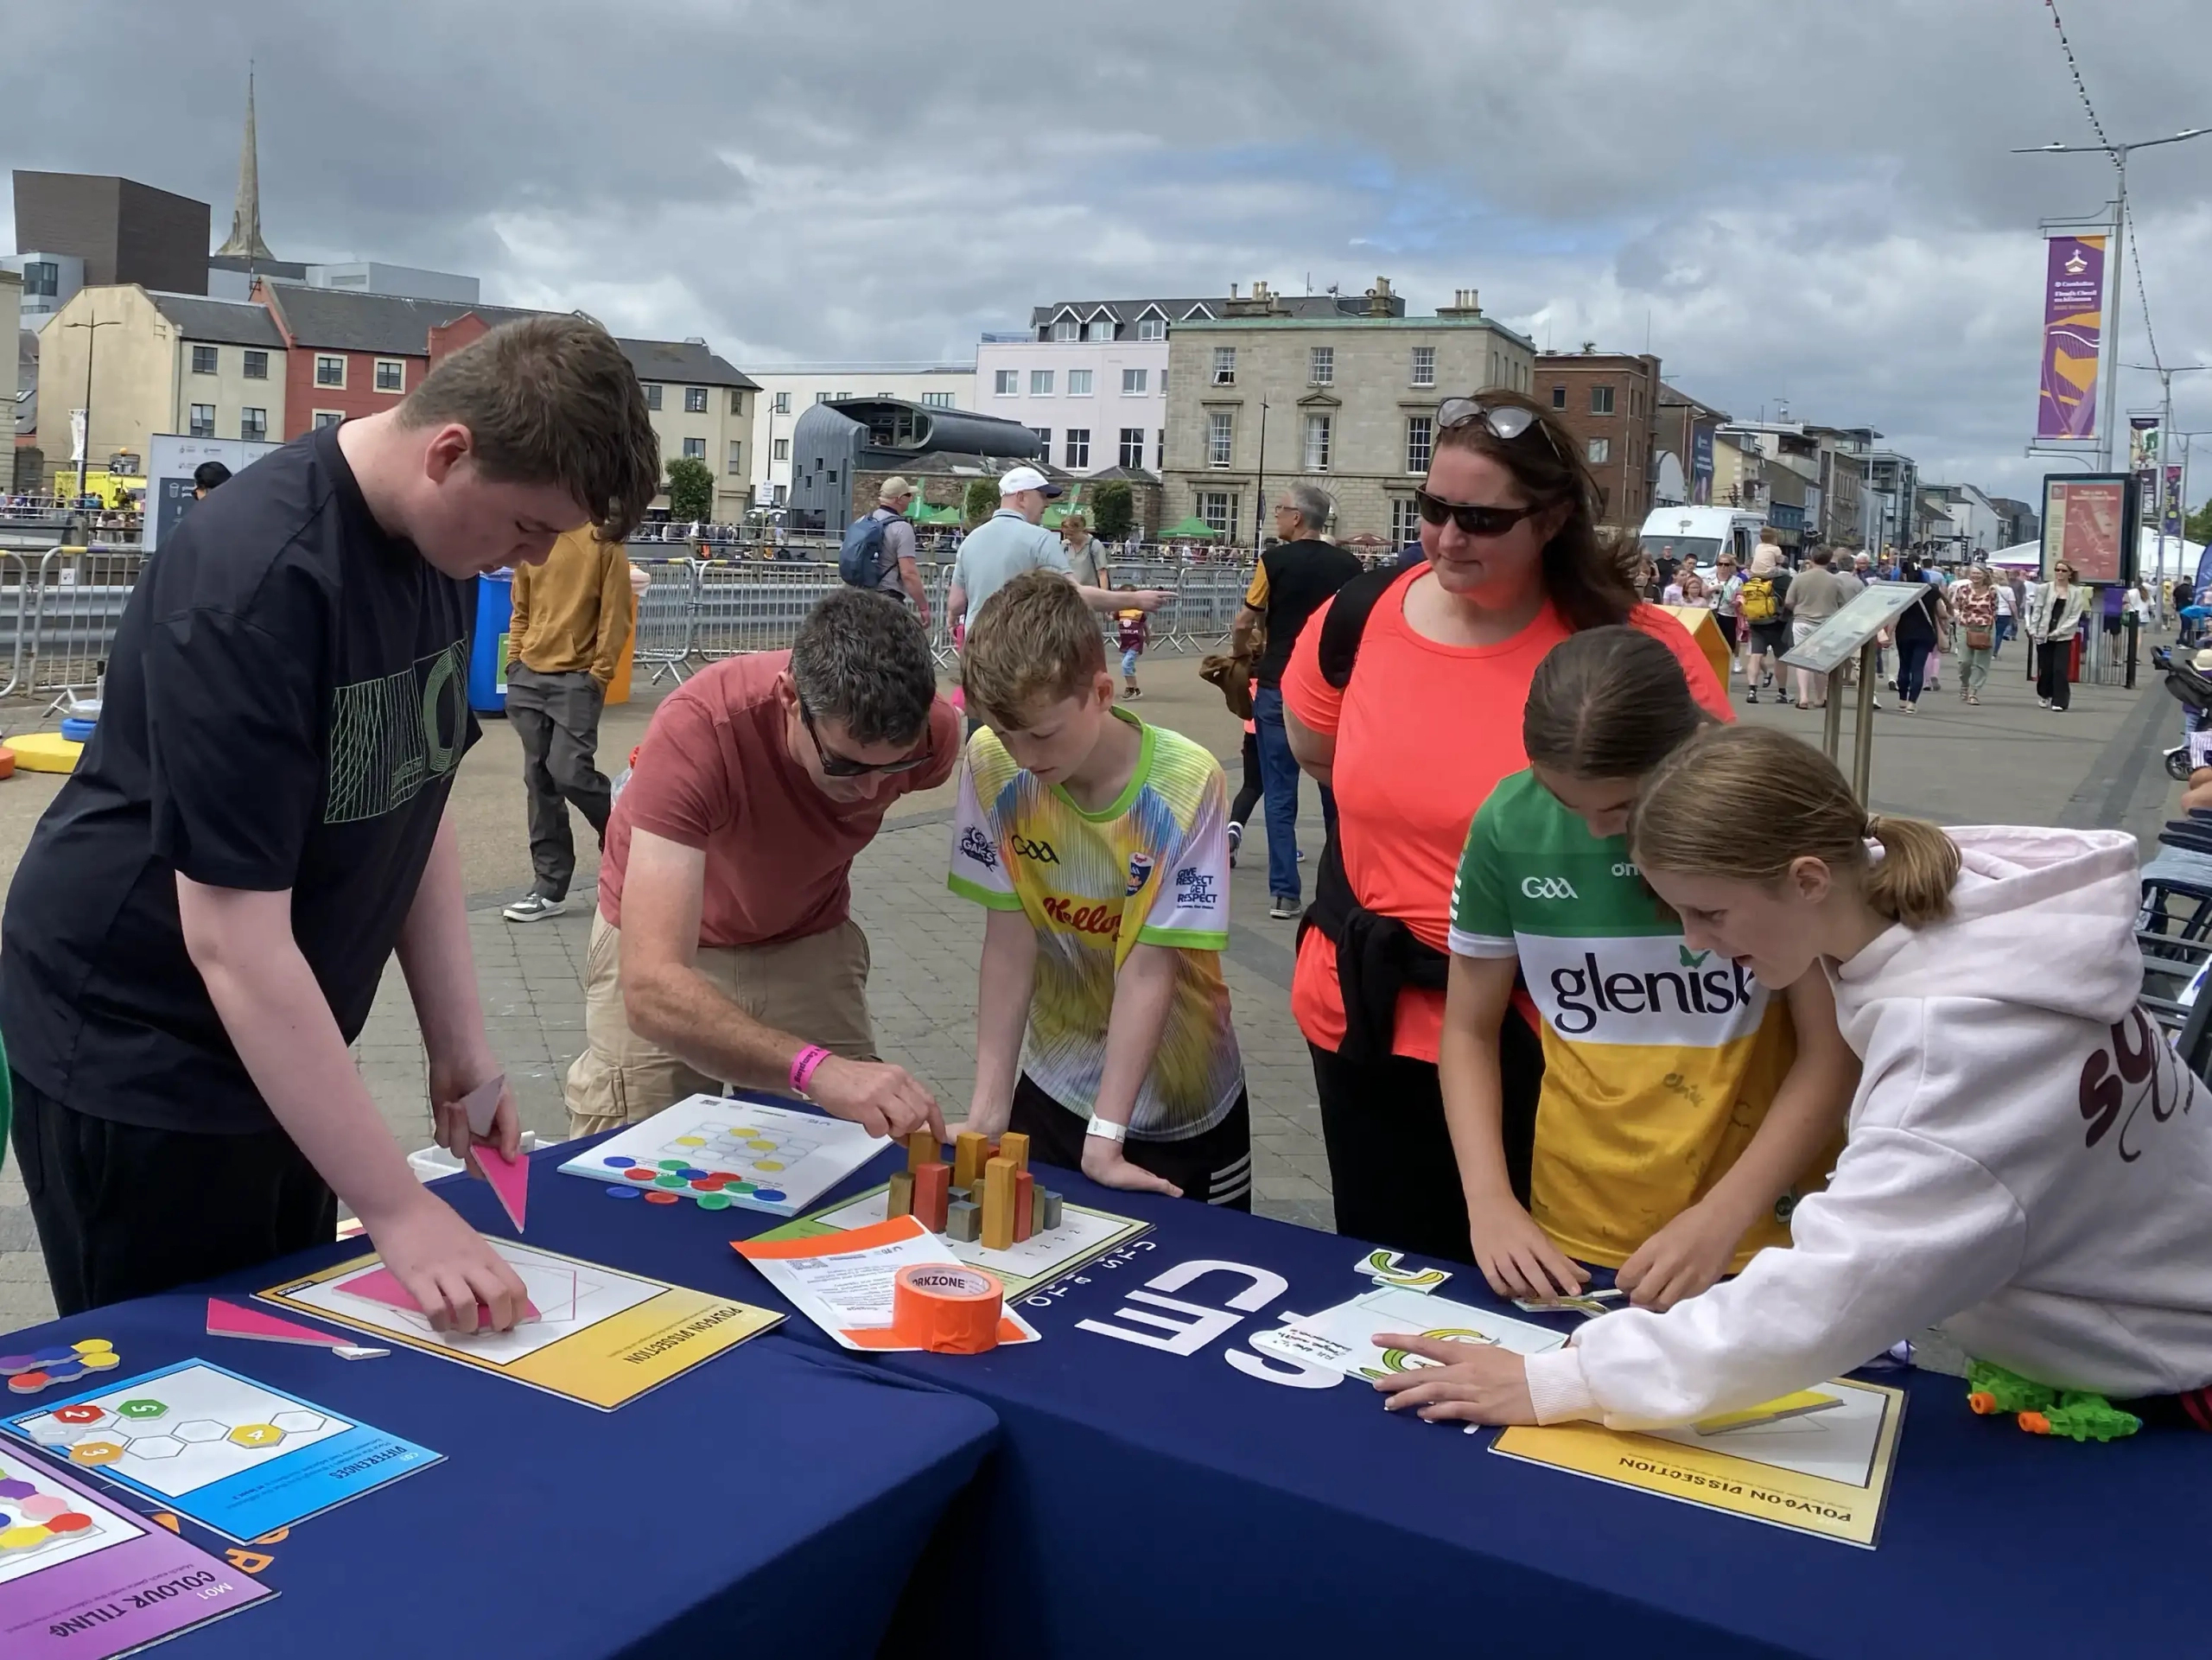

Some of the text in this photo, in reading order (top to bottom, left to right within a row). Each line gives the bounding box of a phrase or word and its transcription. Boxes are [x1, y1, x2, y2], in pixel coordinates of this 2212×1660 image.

[1178, 867, 1198, 878] GIVE
[1176, 875, 1214, 887] RESPECT
[1190, 884, 1208, 894] GET
[1522, 876, 1579, 900] GAA
[1177, 894, 1217, 904] RESPECT
[912, 1275, 965, 1289] ORKZONE
[693, 1306, 743, 1333] POLYGON
[623, 1329, 695, 1364] DISSECTION
[65, 1409, 91, 1418] 2
[130, 1404, 158, 1413] 5
[246, 1430, 264, 1441] 4
[82, 1447, 109, 1456] 3
[328, 1446, 407, 1480] DIFFERENCES
[1618, 1457, 1742, 1495] DISSECTION
[1751, 1490, 1852, 1523] POLYGON
[123, 1570, 216, 1608] COLOUR
[196, 1582, 234, 1600] M01
[49, 1603, 127, 1638] TILING
